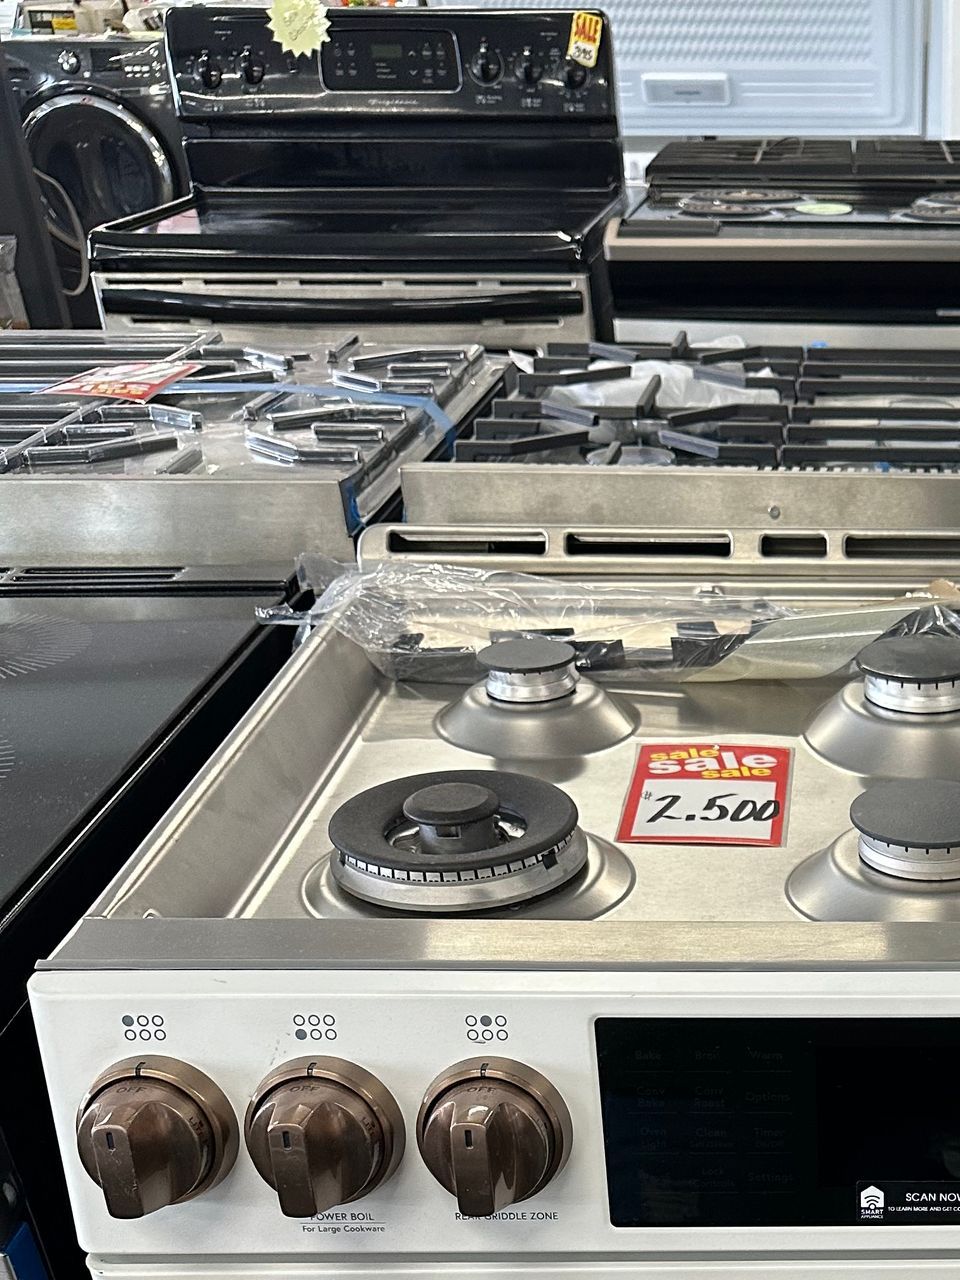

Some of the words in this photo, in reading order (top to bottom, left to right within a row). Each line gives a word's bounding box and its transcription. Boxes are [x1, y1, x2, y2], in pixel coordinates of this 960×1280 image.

[650, 748, 720, 761] sale
[647, 751, 778, 775] sale
[701, 766, 772, 779] sale
[905, 1192, 937, 1202] SCAN
[350, 1212, 375, 1221] BOIL
[530, 1211, 560, 1221] ZONE
[302, 1225, 316, 1233] For
[318, 1225, 341, 1235] Large
[343, 1224, 386, 1233] Cookware
